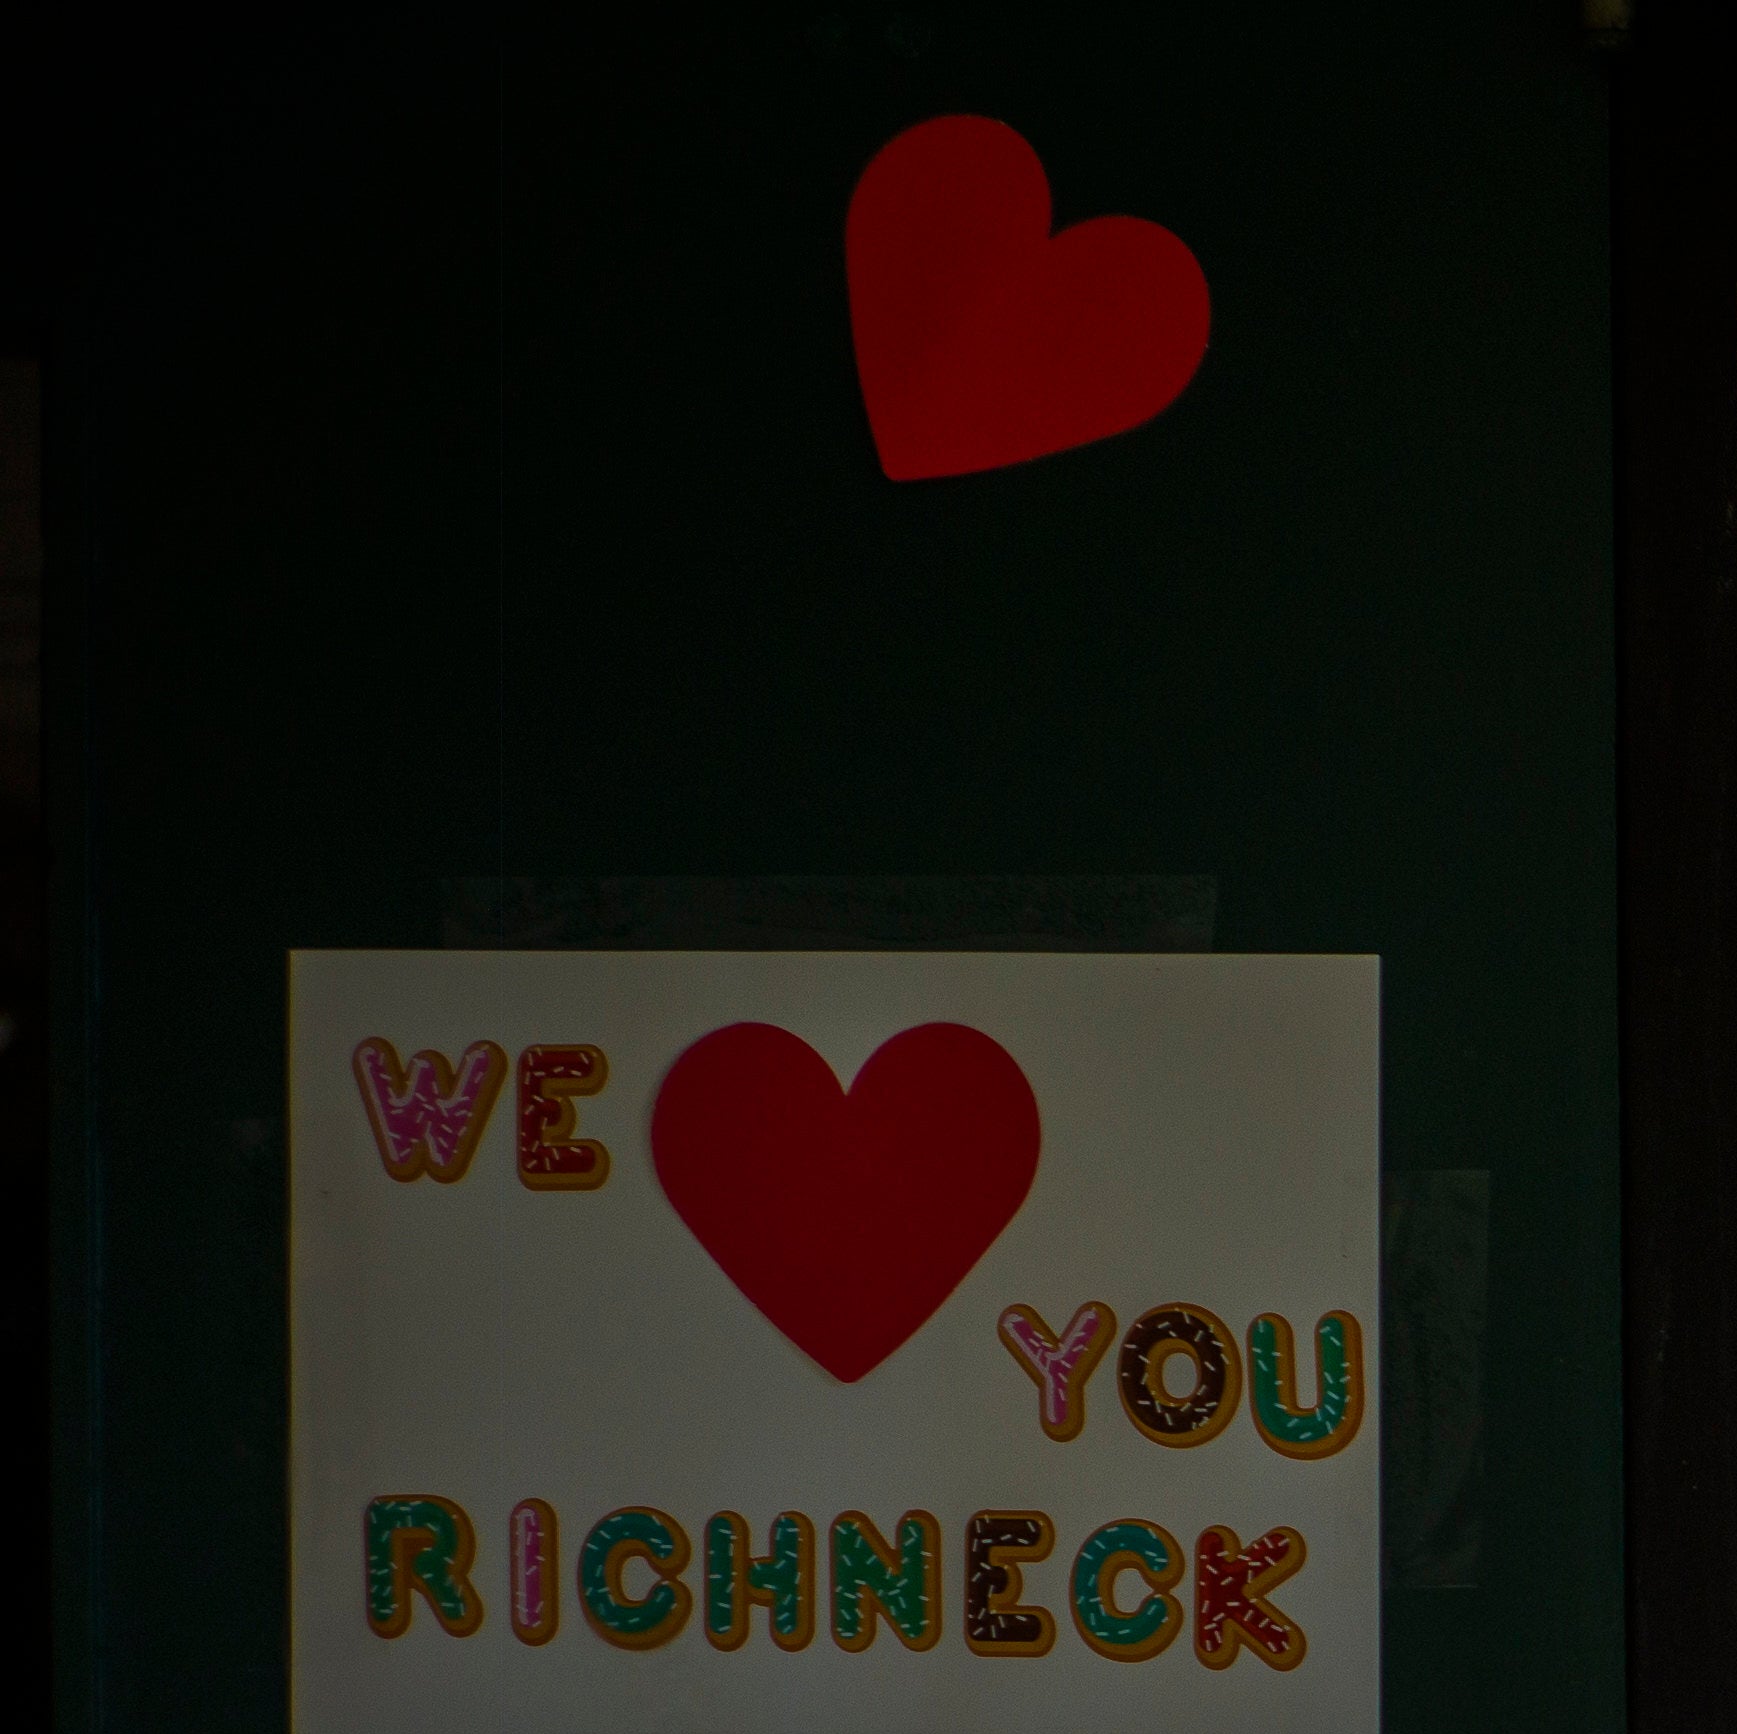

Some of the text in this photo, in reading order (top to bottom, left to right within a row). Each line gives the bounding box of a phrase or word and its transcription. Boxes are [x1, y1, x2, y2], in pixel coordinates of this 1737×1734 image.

[351, 1036, 613, 1193] WE
[997, 1301, 1366, 1462] YOU
[366, 1494, 1309, 1672] RICHNECK
